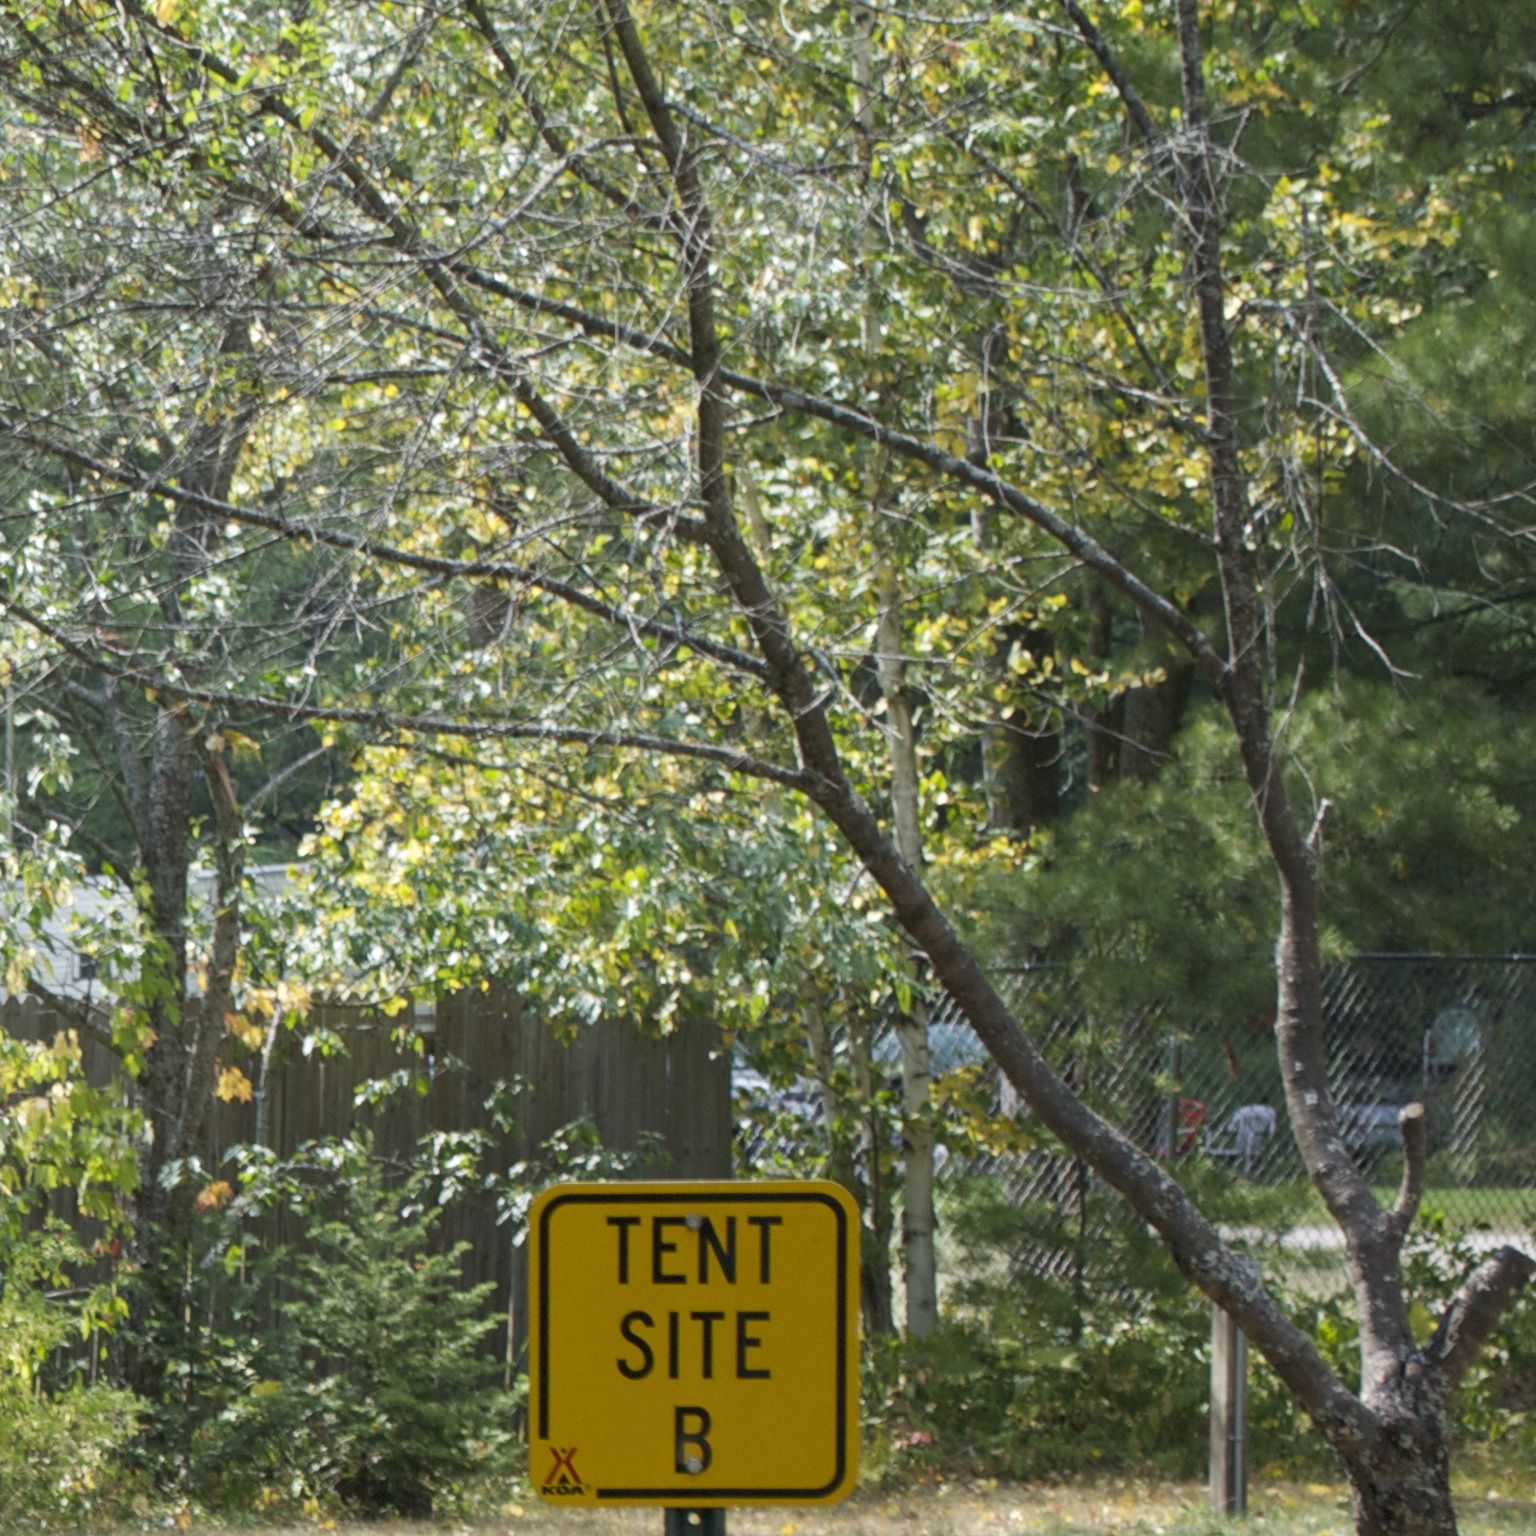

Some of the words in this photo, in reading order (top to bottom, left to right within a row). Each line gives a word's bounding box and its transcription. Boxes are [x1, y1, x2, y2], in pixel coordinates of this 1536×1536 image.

[607, 1216, 782, 1284] TENT
[617, 1311, 771, 1380] SITE
[675, 1406, 713, 1475] B
